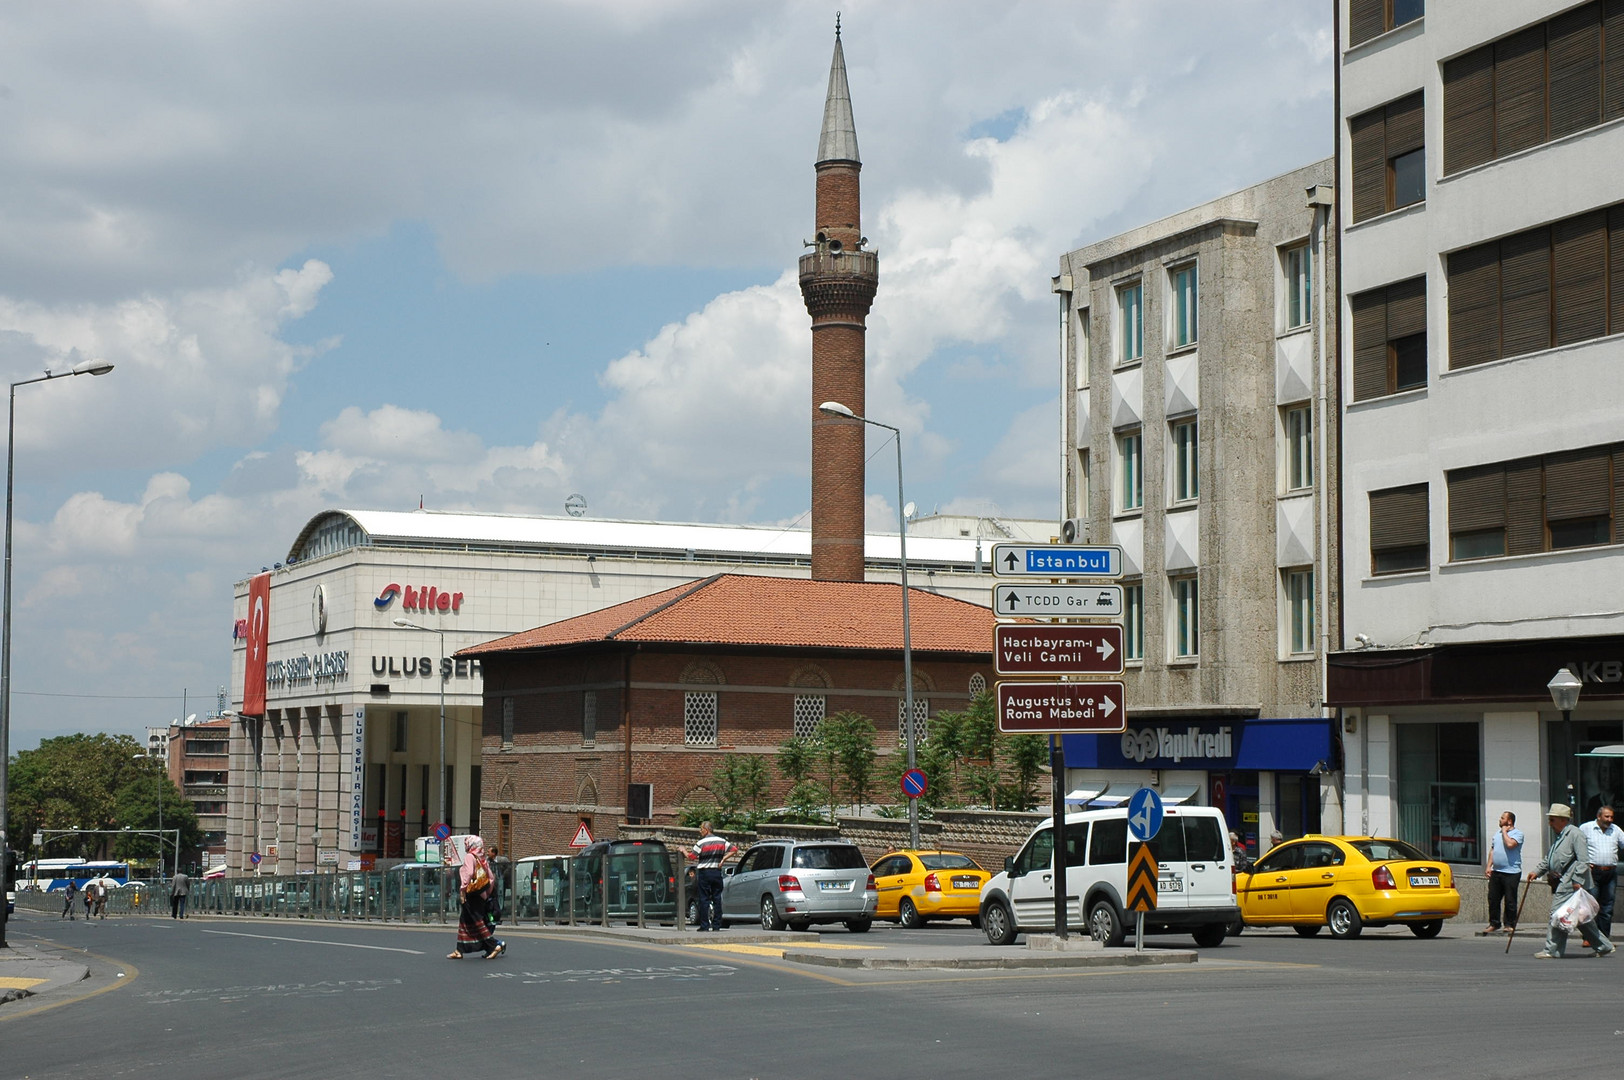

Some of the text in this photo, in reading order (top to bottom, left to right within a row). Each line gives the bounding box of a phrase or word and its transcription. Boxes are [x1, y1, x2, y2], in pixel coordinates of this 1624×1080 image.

[1029, 551, 1106, 568] İstanbul
[402, 585, 463, 611] kiler
[1026, 596, 1088, 606] TCDD Gar
[1003, 637, 1093, 650] Hacıbayram-ı
[1004, 652, 1082, 662] Veli Camii
[372, 656, 432, 676] ULUS
[1006, 696, 1094, 708] Augustus ve
[1006, 708, 1094, 719] Roma Mabedi
[355, 712, 363, 743] ULUS
